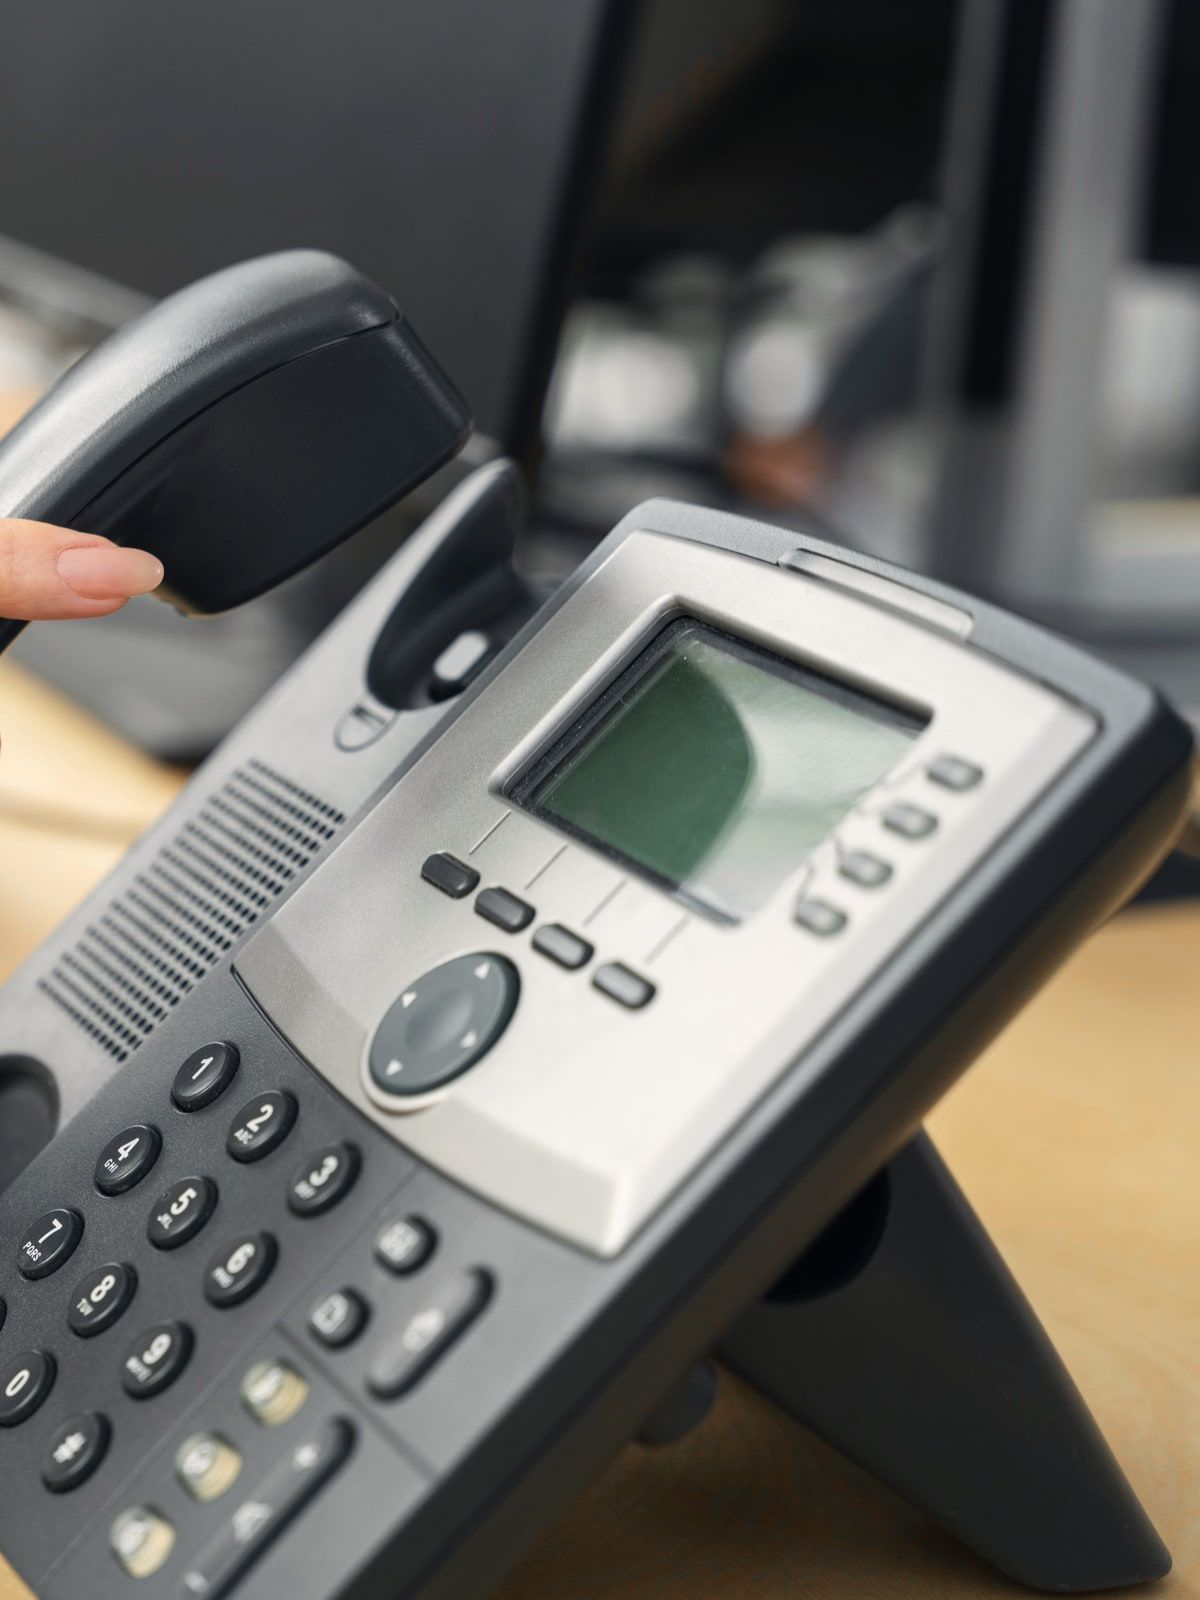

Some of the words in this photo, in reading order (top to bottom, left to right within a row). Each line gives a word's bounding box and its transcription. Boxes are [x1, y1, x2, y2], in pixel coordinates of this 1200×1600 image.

[192, 1056, 214, 1080] 1
[246, 1104, 274, 1132] 2
[118, 1138, 140, 1161] 4
[104, 1158, 119, 1173] GHI
[309, 1156, 338, 1187] 3
[170, 1187, 198, 1216] 5
[38, 1218, 63, 1244] 7
[22, 1241, 42, 1262] PQRS
[226, 1243, 256, 1274] 6
[90, 1274, 116, 1302] 8
[142, 1333, 171, 1365] 9
[5, 1369, 30, 1397] 0
